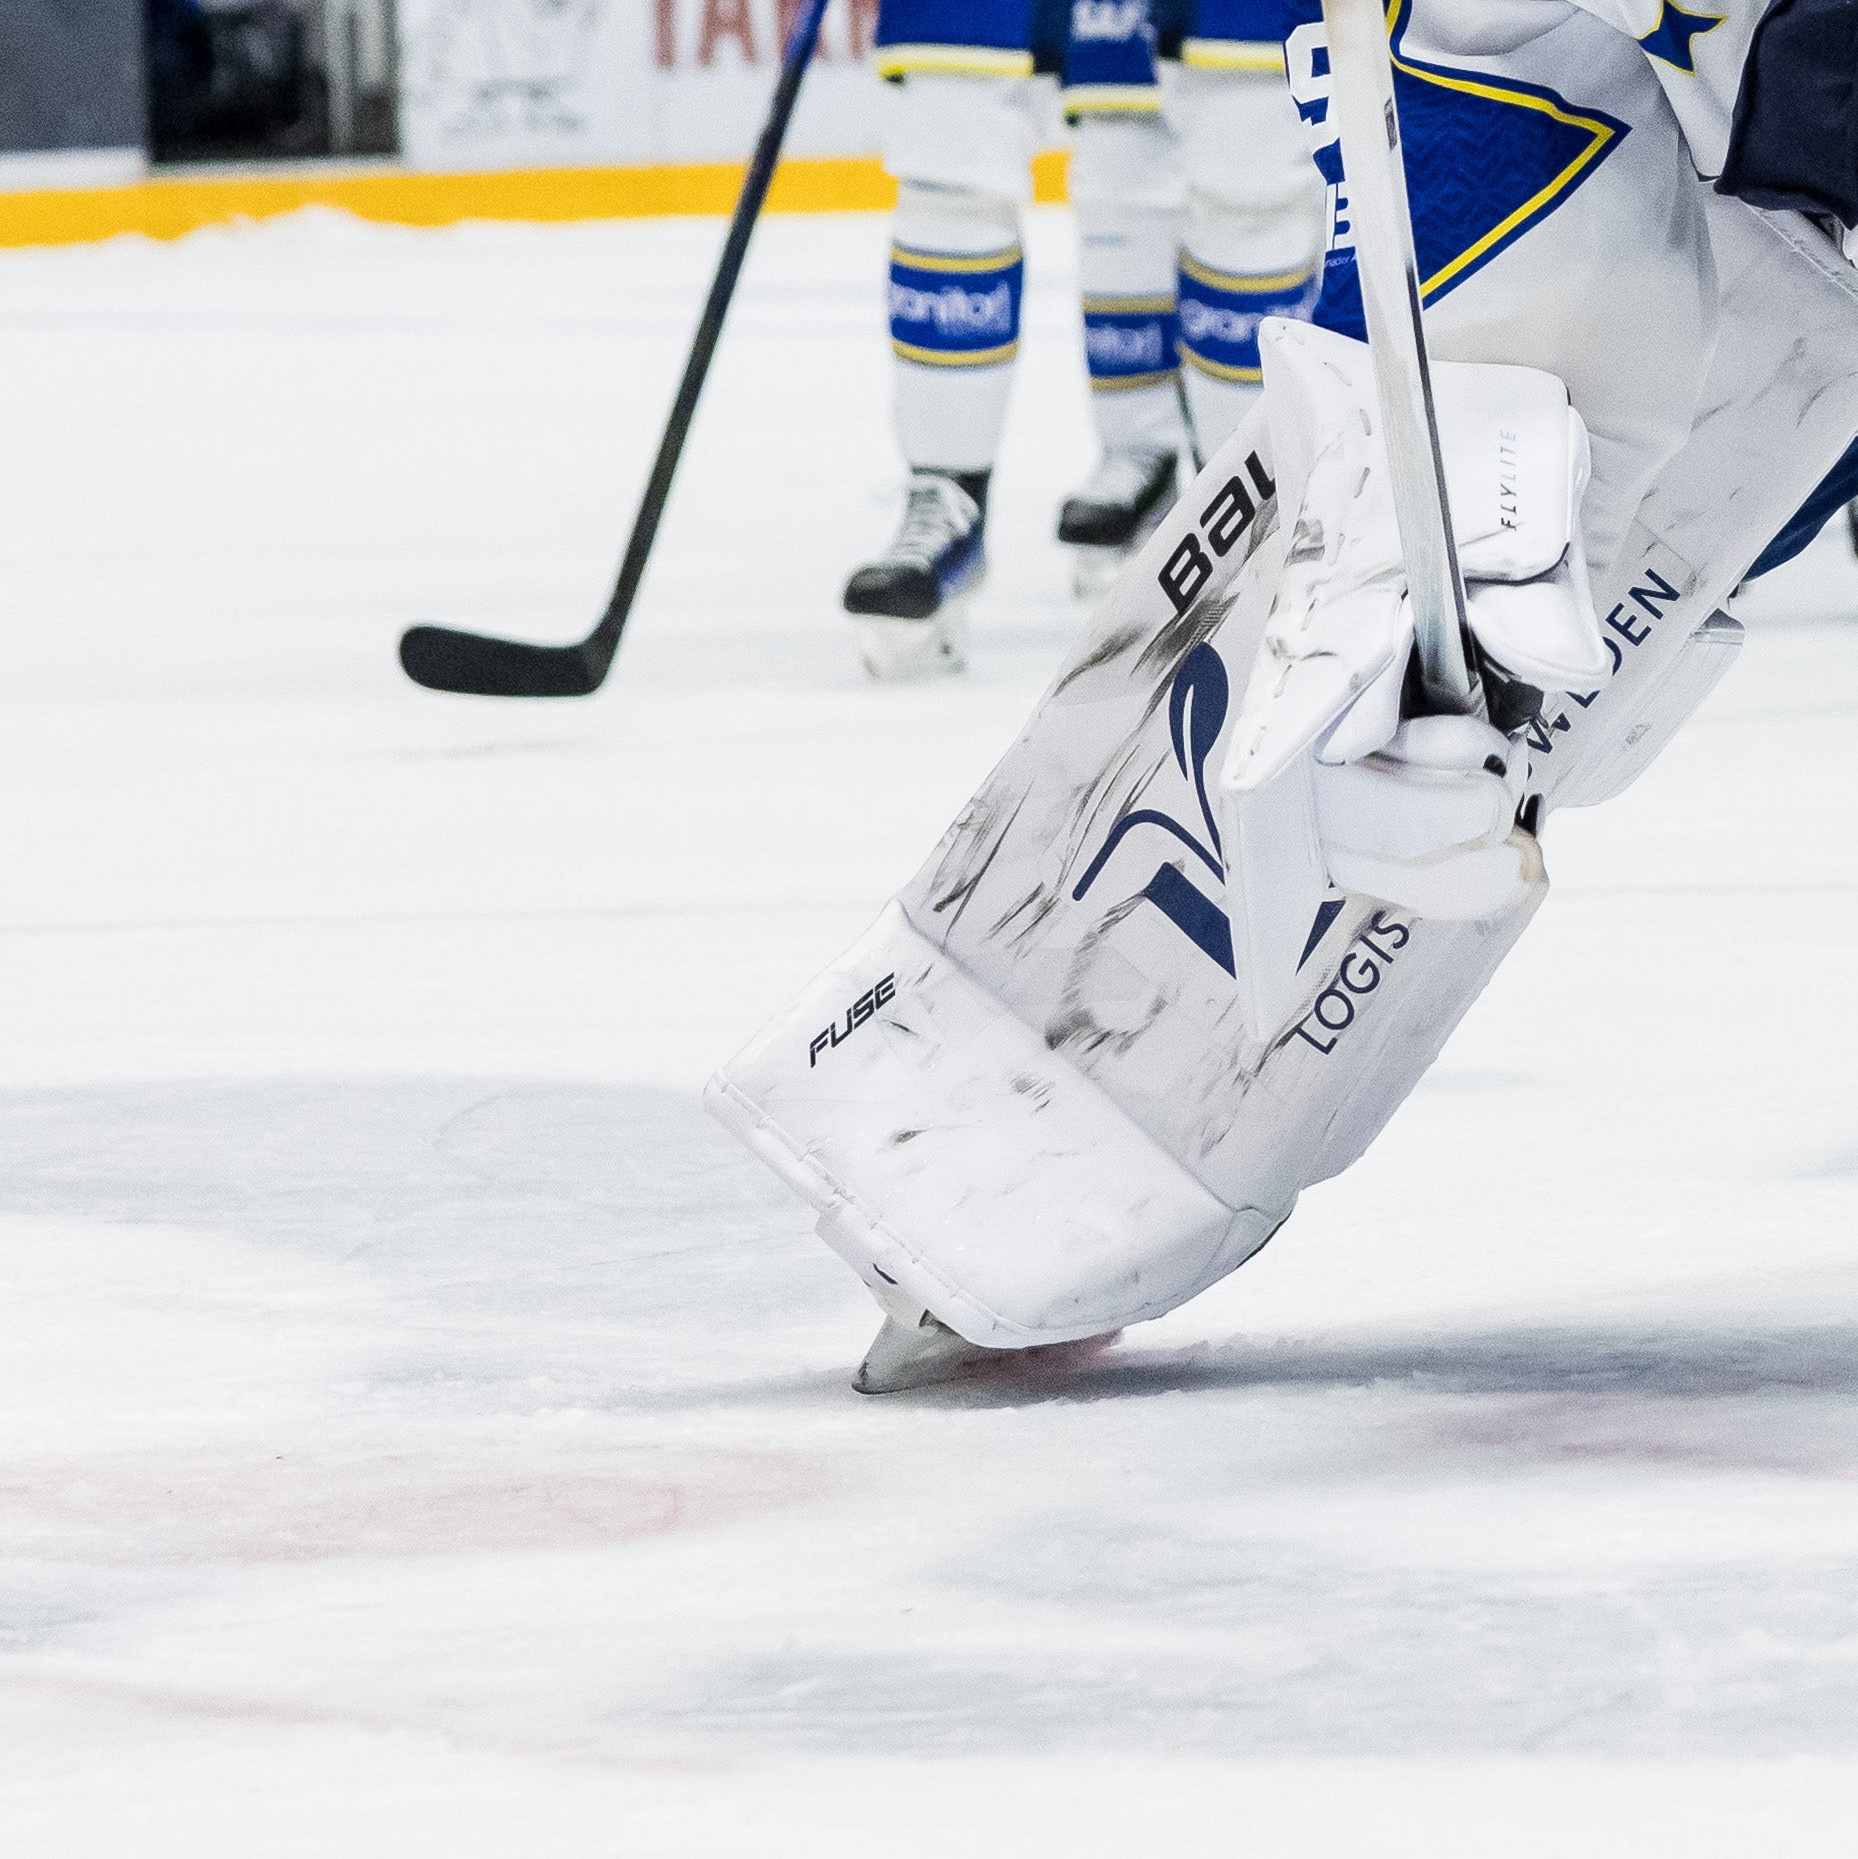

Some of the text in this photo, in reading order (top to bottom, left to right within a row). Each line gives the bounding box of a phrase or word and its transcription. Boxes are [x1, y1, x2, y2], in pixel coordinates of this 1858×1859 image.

[1157, 449, 1280, 615] BAU
[1499, 428, 1518, 532] FLYLITE
[808, 971, 897, 1069] FUSE
[1293, 911, 1412, 1057] LOGIS
